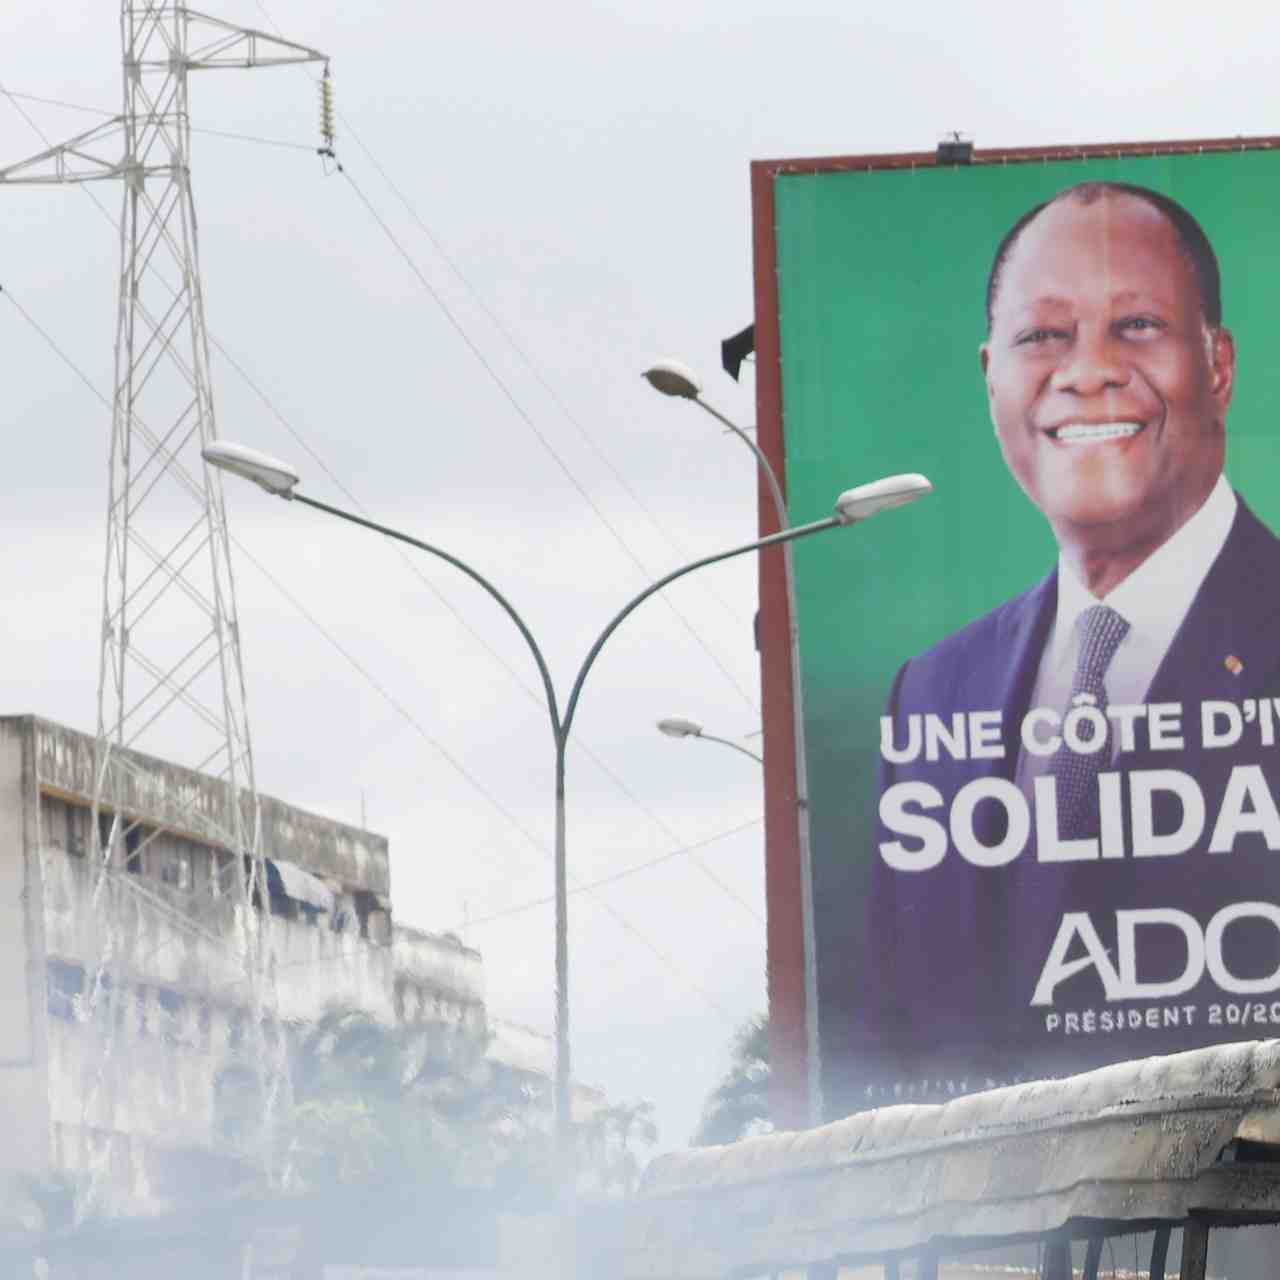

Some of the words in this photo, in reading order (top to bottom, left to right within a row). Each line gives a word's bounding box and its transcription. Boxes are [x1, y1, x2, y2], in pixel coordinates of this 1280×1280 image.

[880, 712, 1005, 765] UNE
[1020, 690, 1183, 756] CÔTE
[1045, 1002, 1199, 1033] PRÉSIDENT
